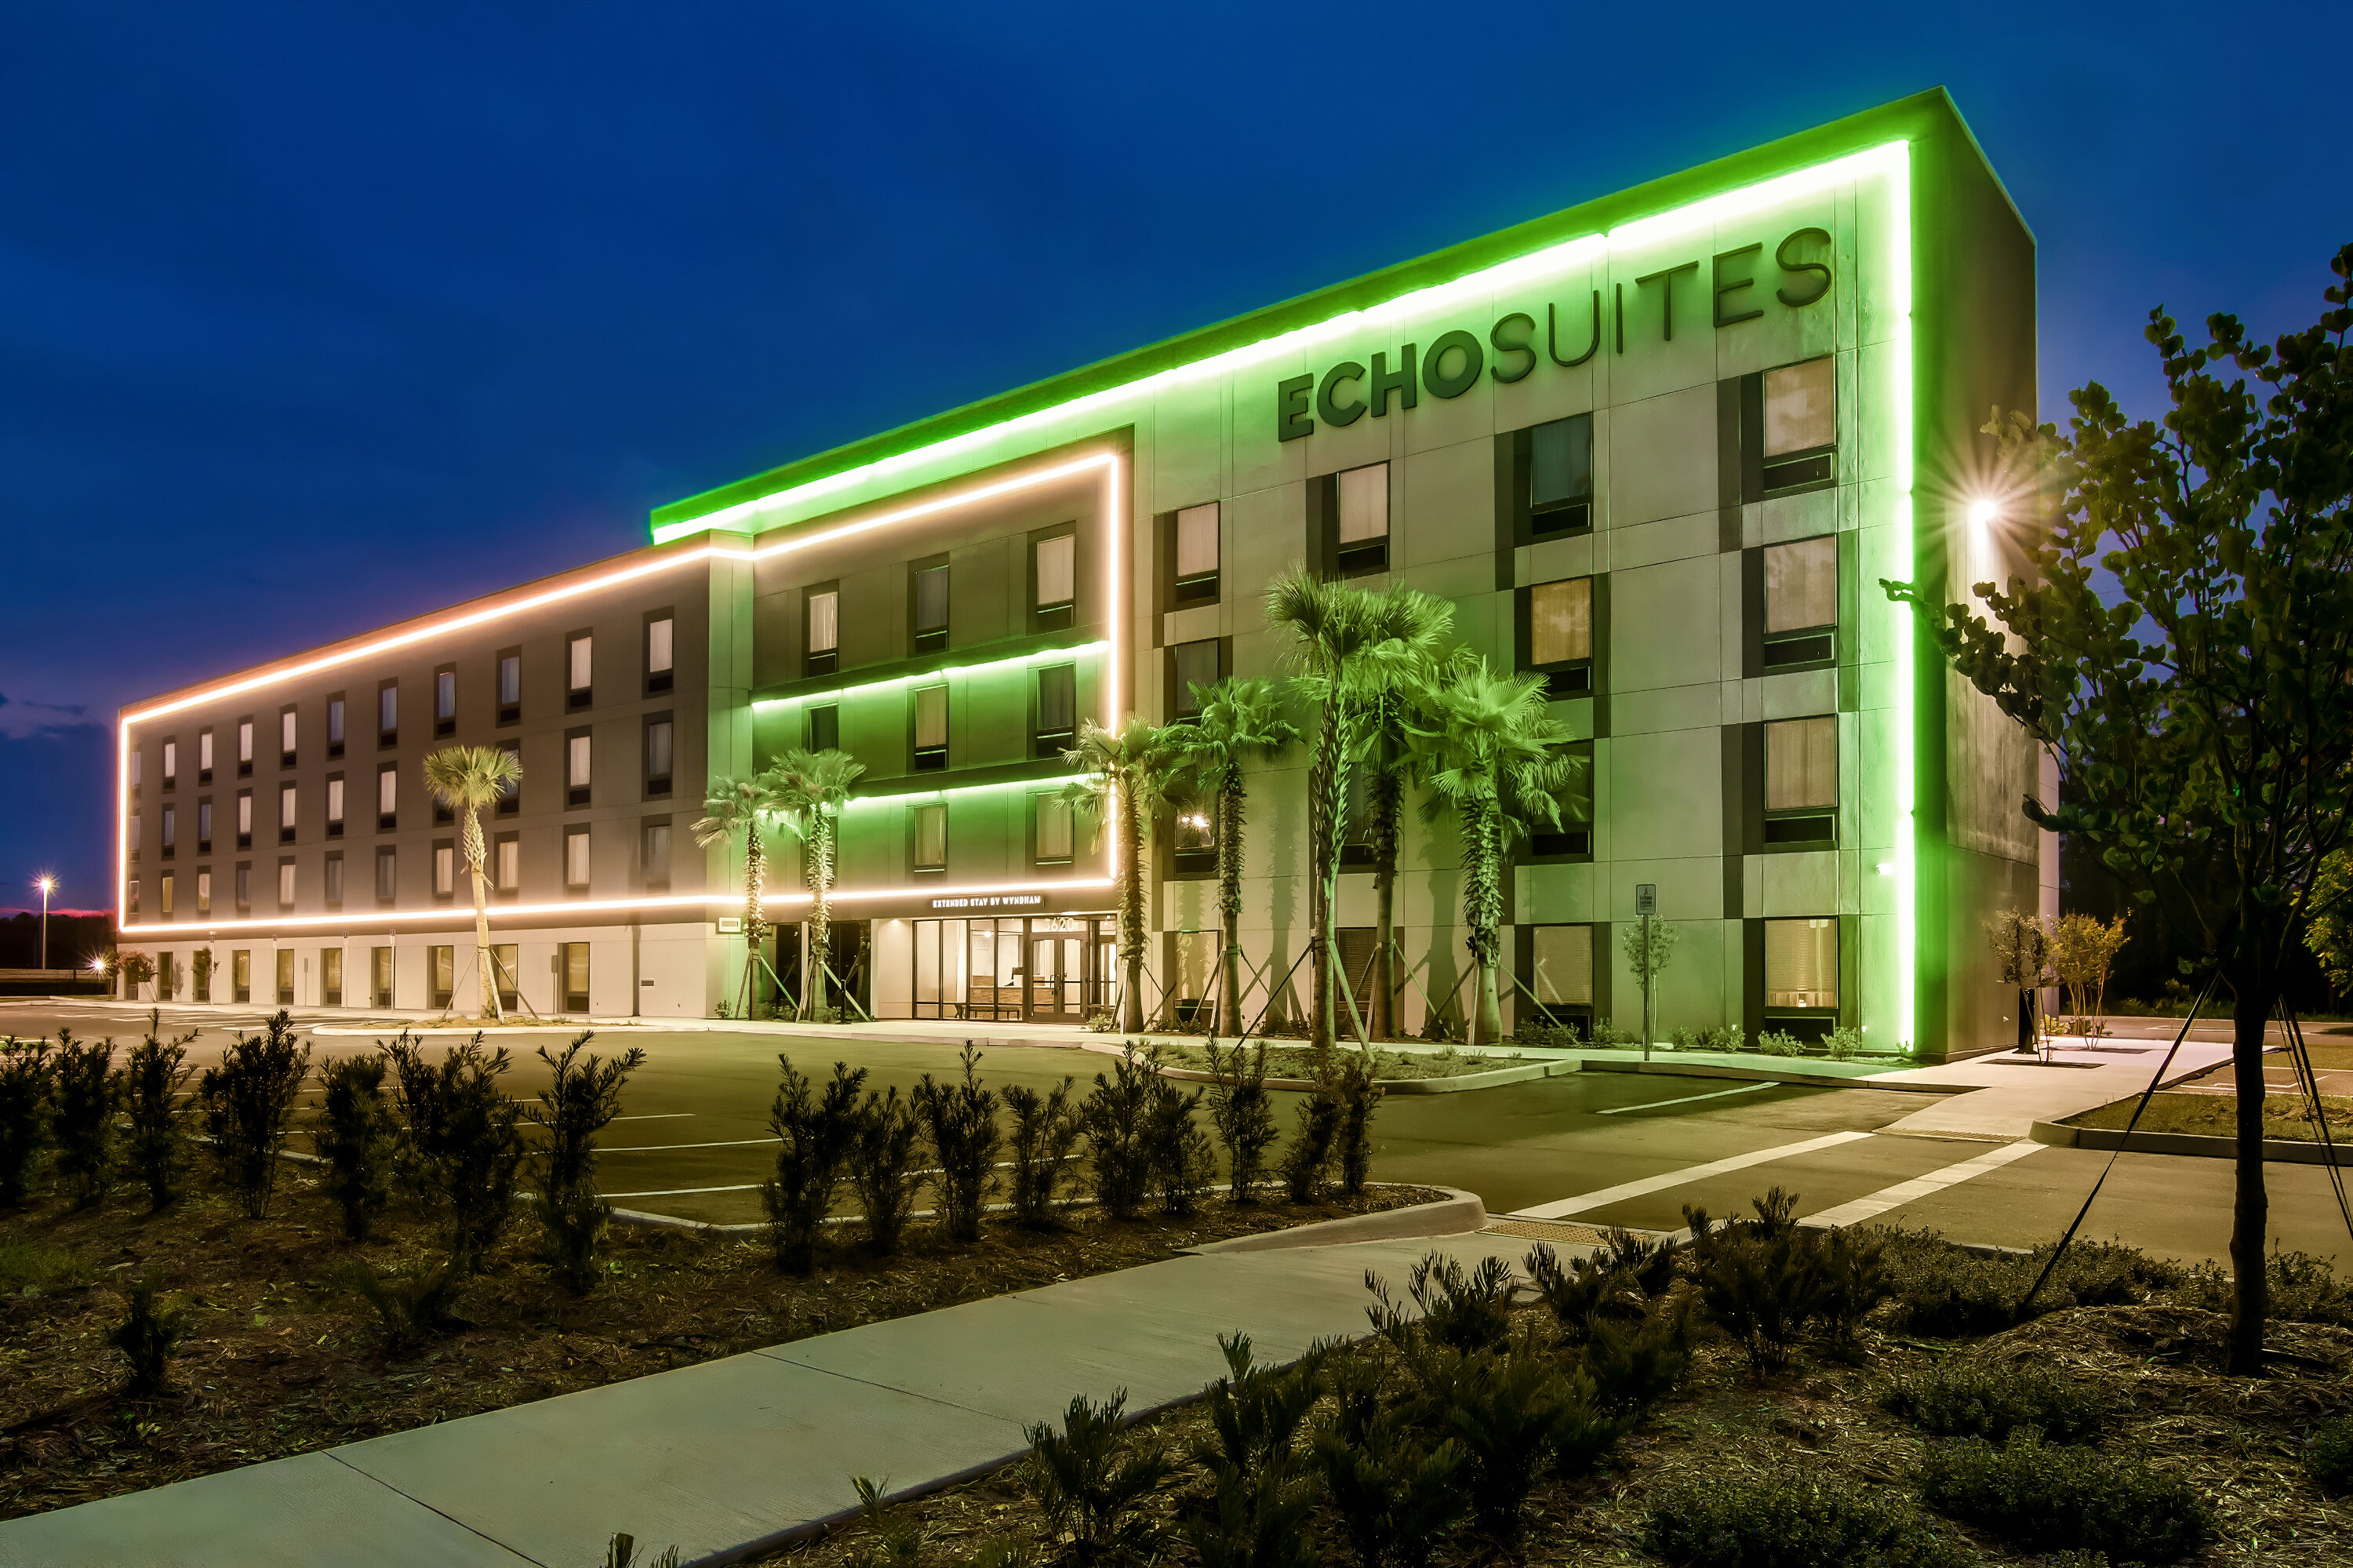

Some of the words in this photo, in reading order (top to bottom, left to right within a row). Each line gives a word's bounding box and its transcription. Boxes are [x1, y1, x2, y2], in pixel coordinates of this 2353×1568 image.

[933, 898, 968, 908] EXTENDED
[970, 898, 988, 907] STAY
[990, 897, 1000, 906] BY
[1002, 896, 1041, 905] WYNDHAM
